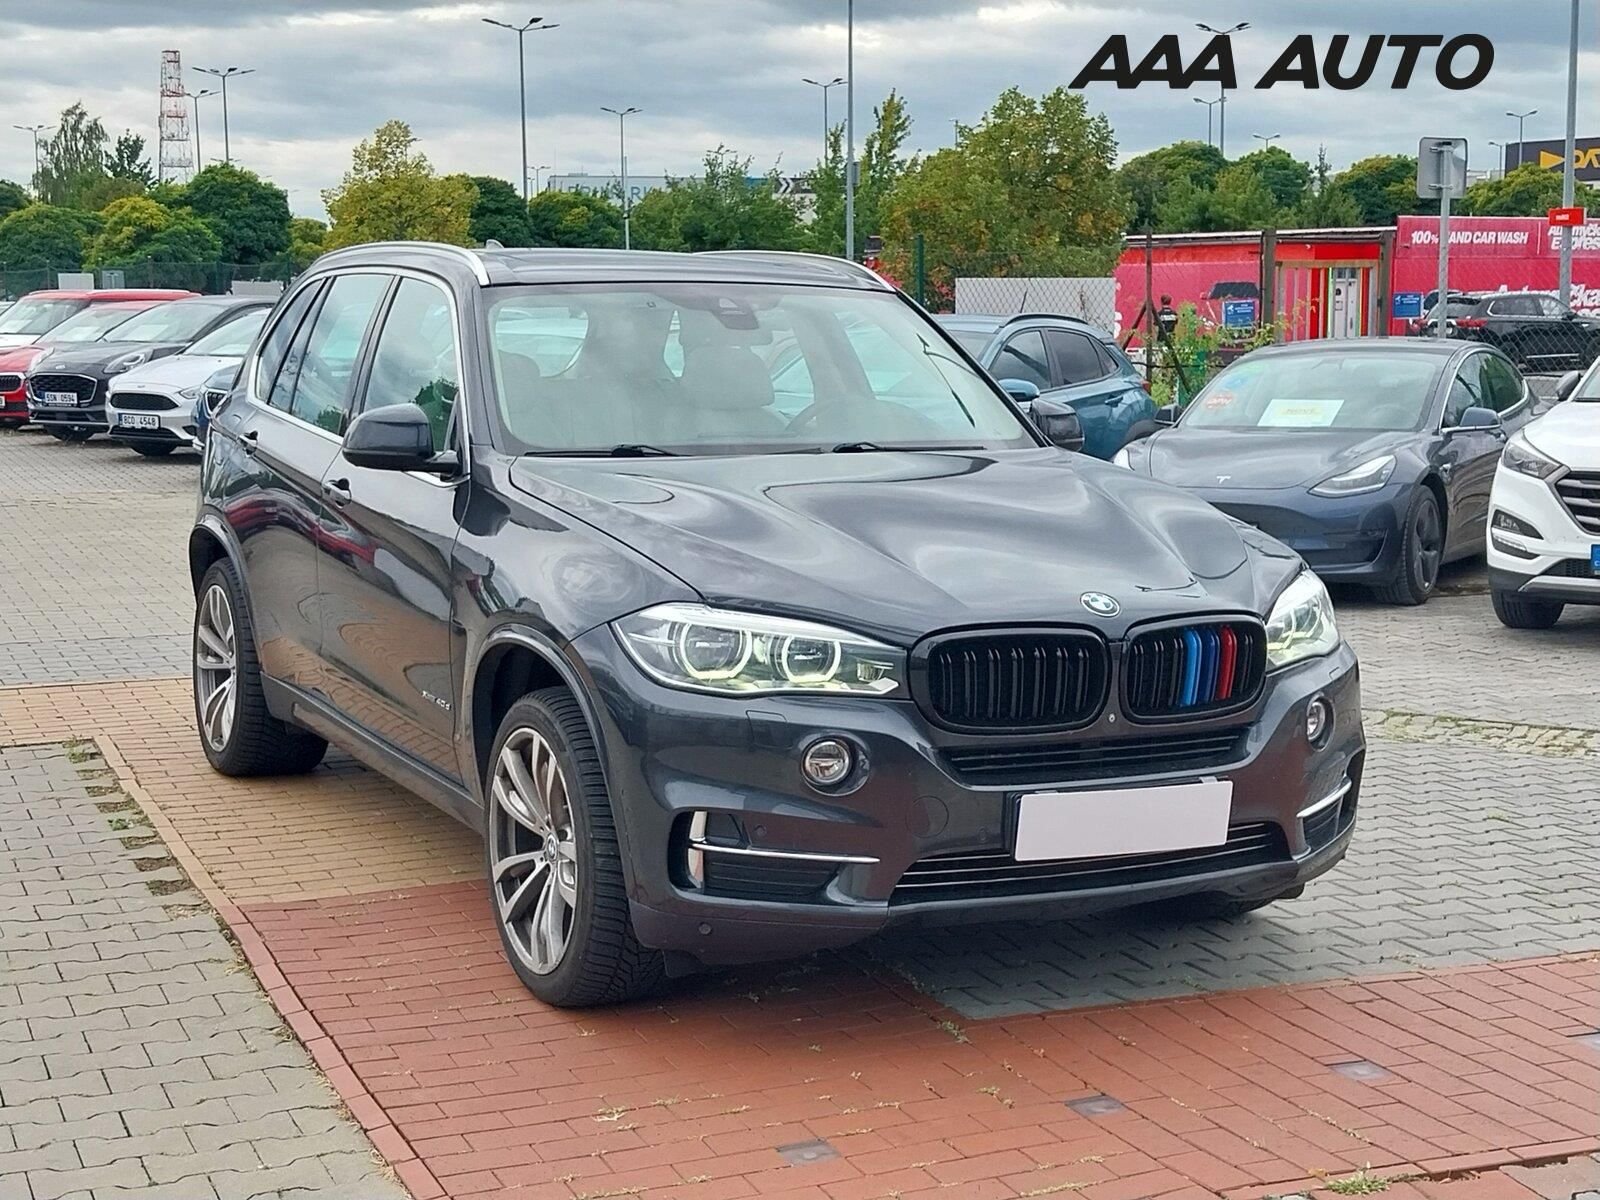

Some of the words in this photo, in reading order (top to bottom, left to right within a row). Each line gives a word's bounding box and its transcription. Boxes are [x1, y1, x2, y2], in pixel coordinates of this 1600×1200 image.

[1411, 230, 1439, 244] 100%
[1447, 231, 1472, 244] AND
[1473, 231, 1496, 244] CAR
[1497, 231, 1529, 244] WASH
[139, 417, 157, 427] 4548
